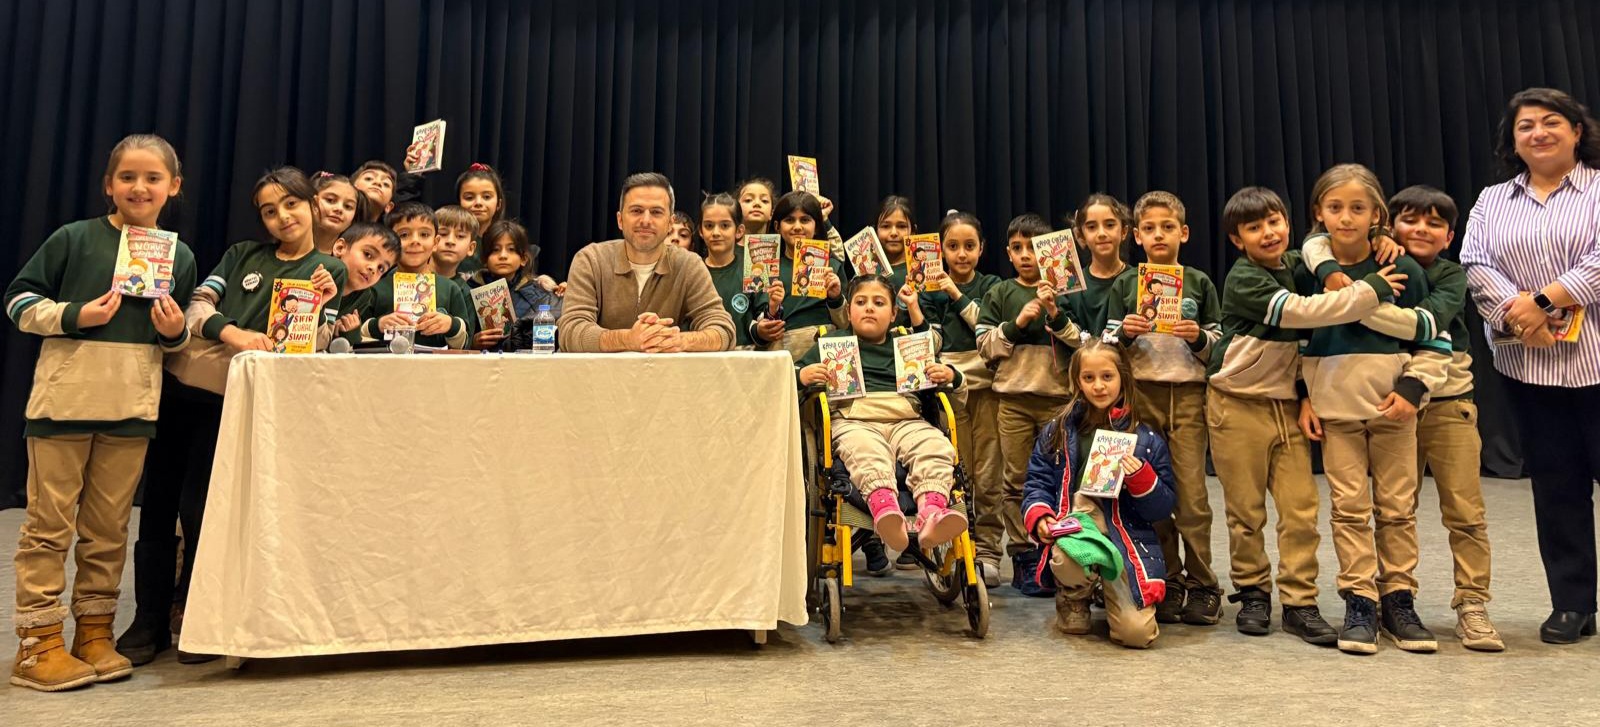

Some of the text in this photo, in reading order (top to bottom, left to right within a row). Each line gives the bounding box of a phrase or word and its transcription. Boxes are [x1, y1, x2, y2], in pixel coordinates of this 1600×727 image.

[1160, 297, 1179, 305] SIFIR
[293, 315, 314, 323] SIFIR
[1157, 312, 1179, 320] SINIFI
[291, 323, 313, 332] KURAL
[288, 333, 311, 341] SINIFI
